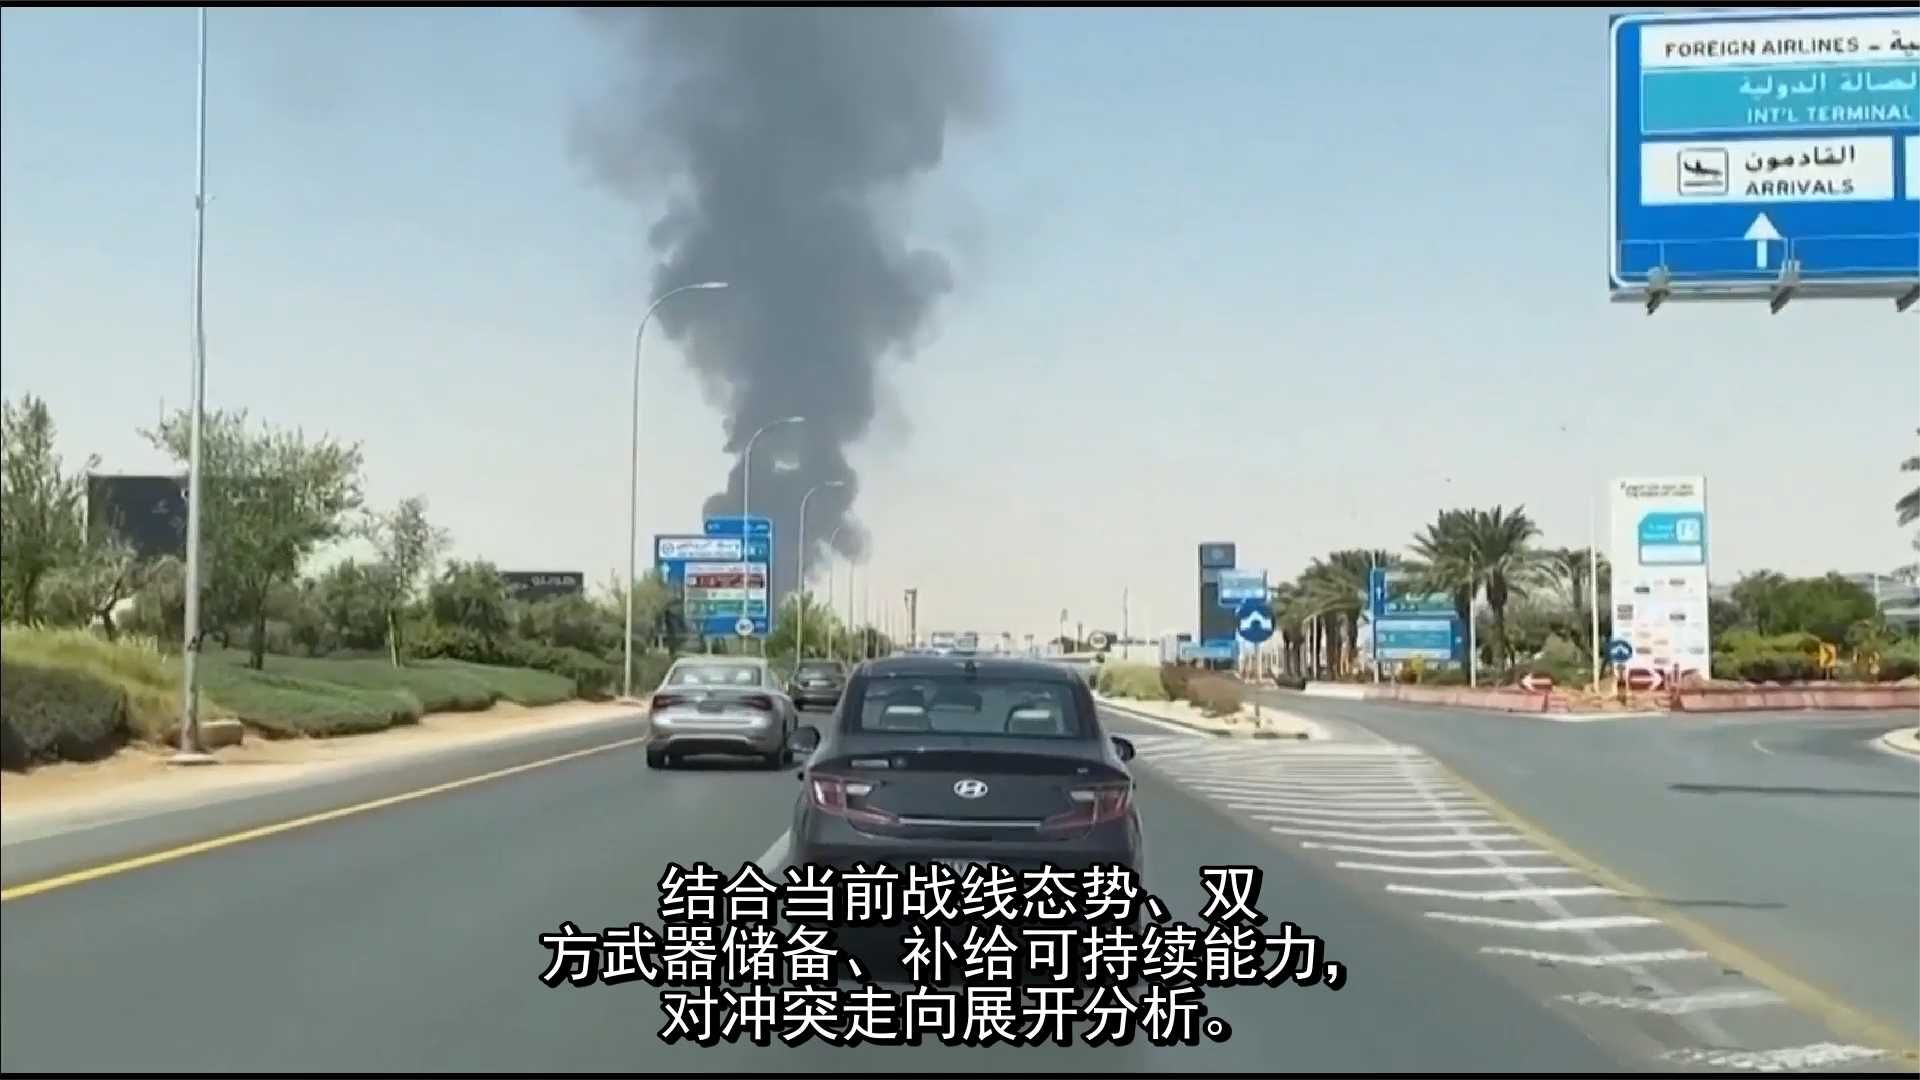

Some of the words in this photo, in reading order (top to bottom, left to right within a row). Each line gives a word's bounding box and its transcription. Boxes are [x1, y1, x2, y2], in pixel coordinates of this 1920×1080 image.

[1665, 40, 1756, 58] FOREIGN
[1761, 36, 1859, 55] AIRLINES
[1739, 71, 1827, 101] الدولية
[1840, 70, 1918, 92] لصالة
[1747, 105, 1799, 125] INT'L
[1806, 103, 1912, 122] TERMINAL
[1745, 143, 1855, 173] القادمون
[1744, 178, 1855, 196] ARRIVALS
